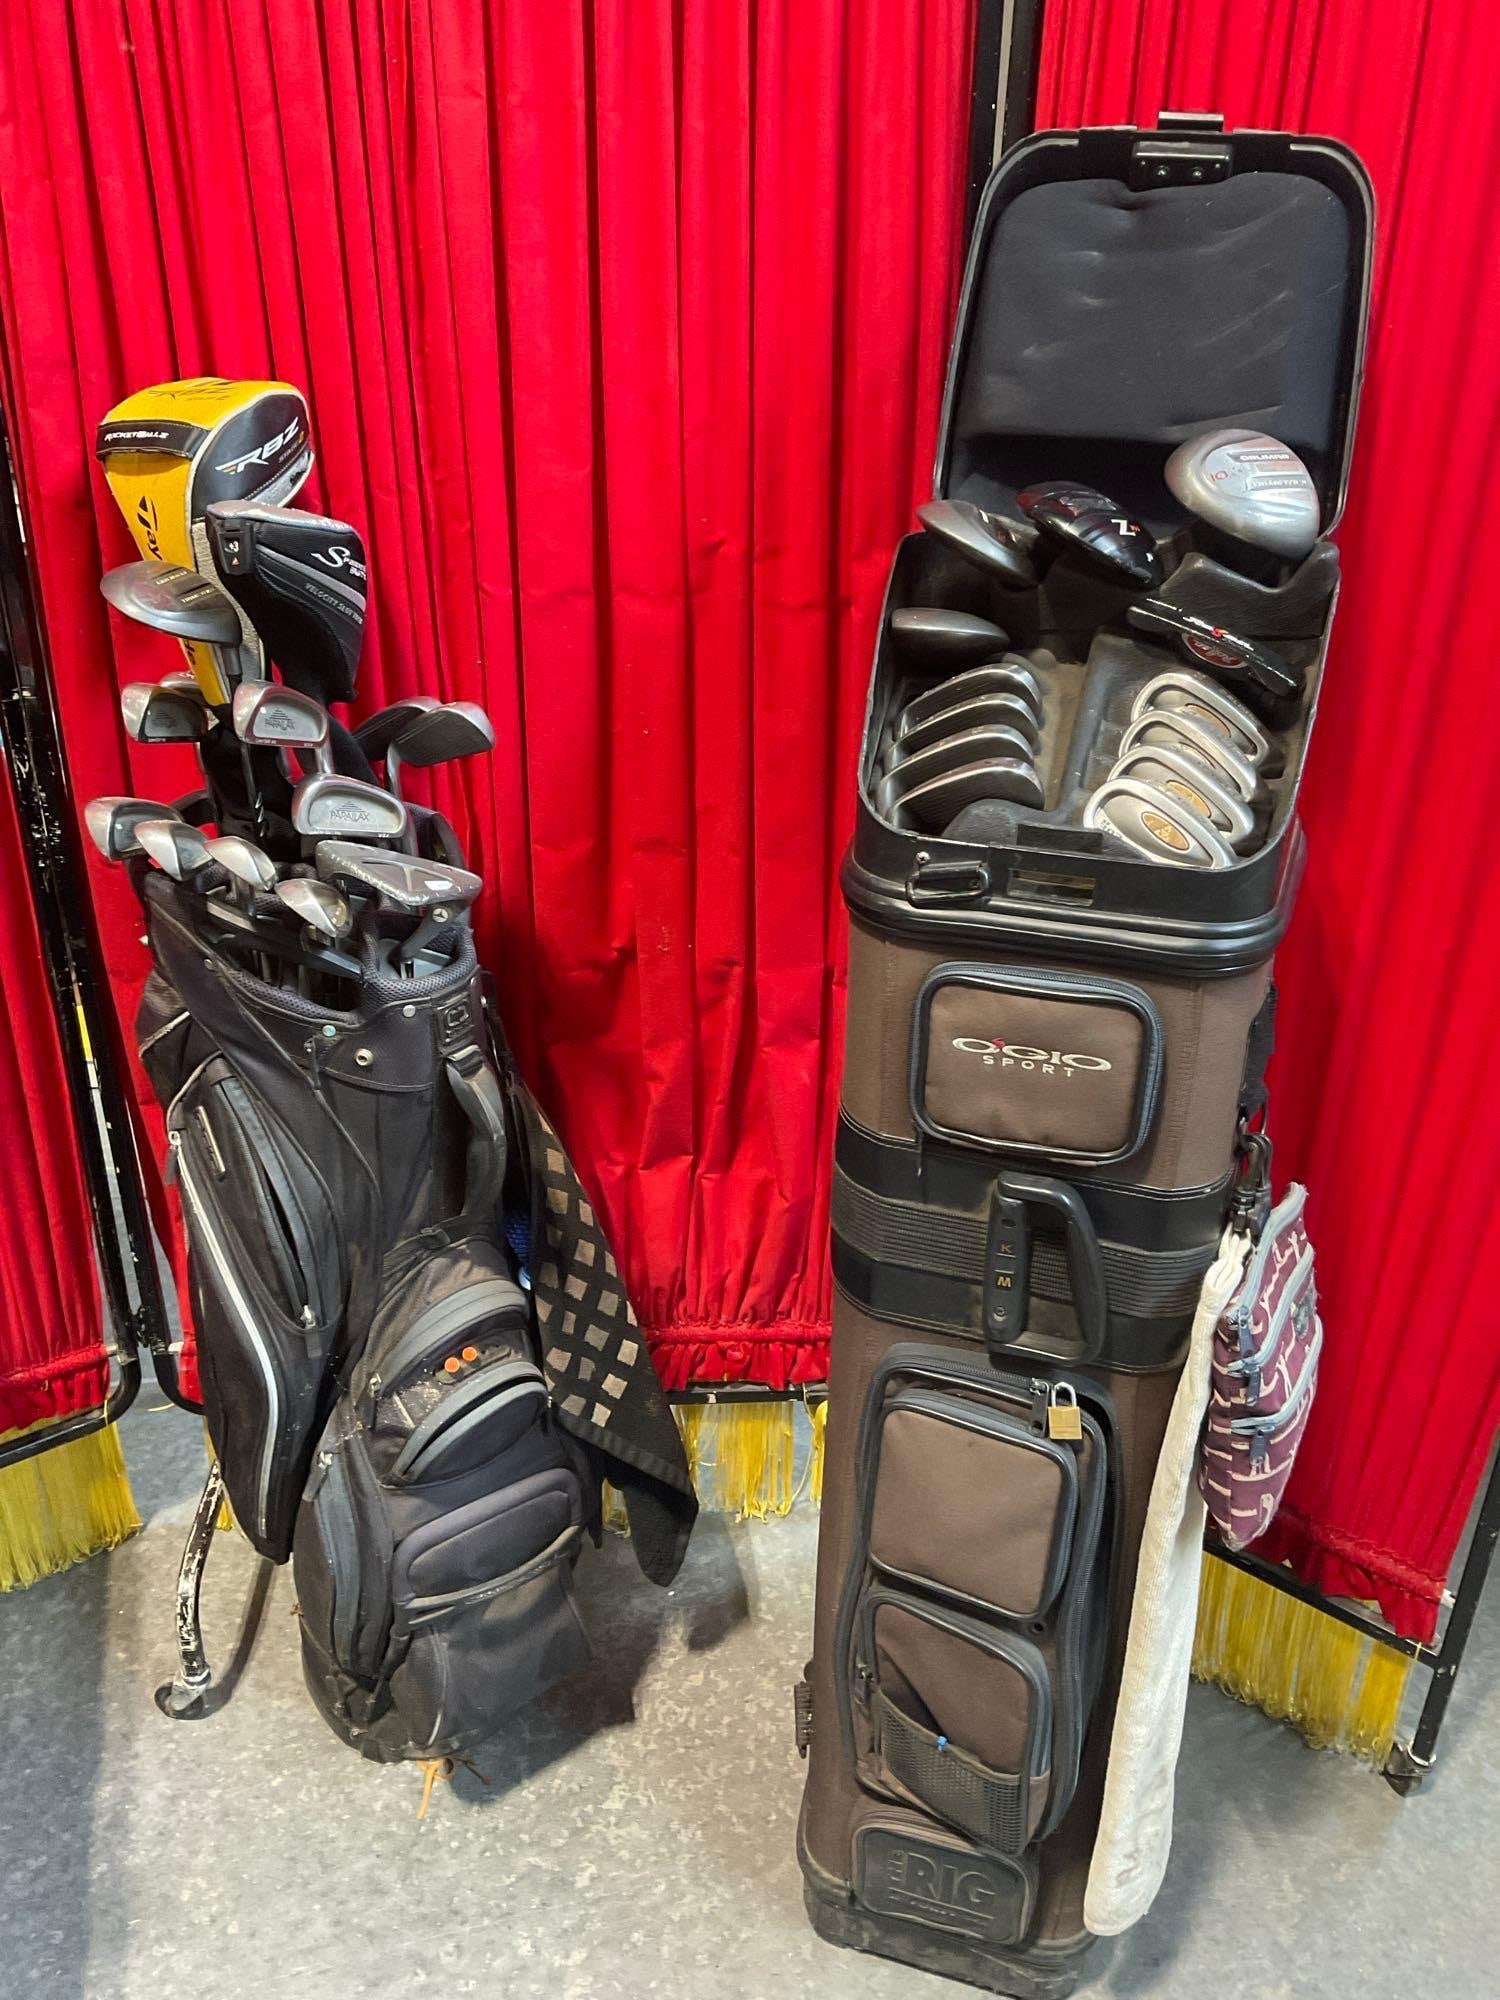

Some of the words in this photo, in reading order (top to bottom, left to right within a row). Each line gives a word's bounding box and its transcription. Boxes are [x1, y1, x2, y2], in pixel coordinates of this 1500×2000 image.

[215, 417, 298, 474] RBZ
[305, 582, 339, 607] VELOCITY
[983, 1055, 1076, 1077] SPORT
[997, 1276, 1012, 1287] M
[903, 1852, 997, 1908] RIG
